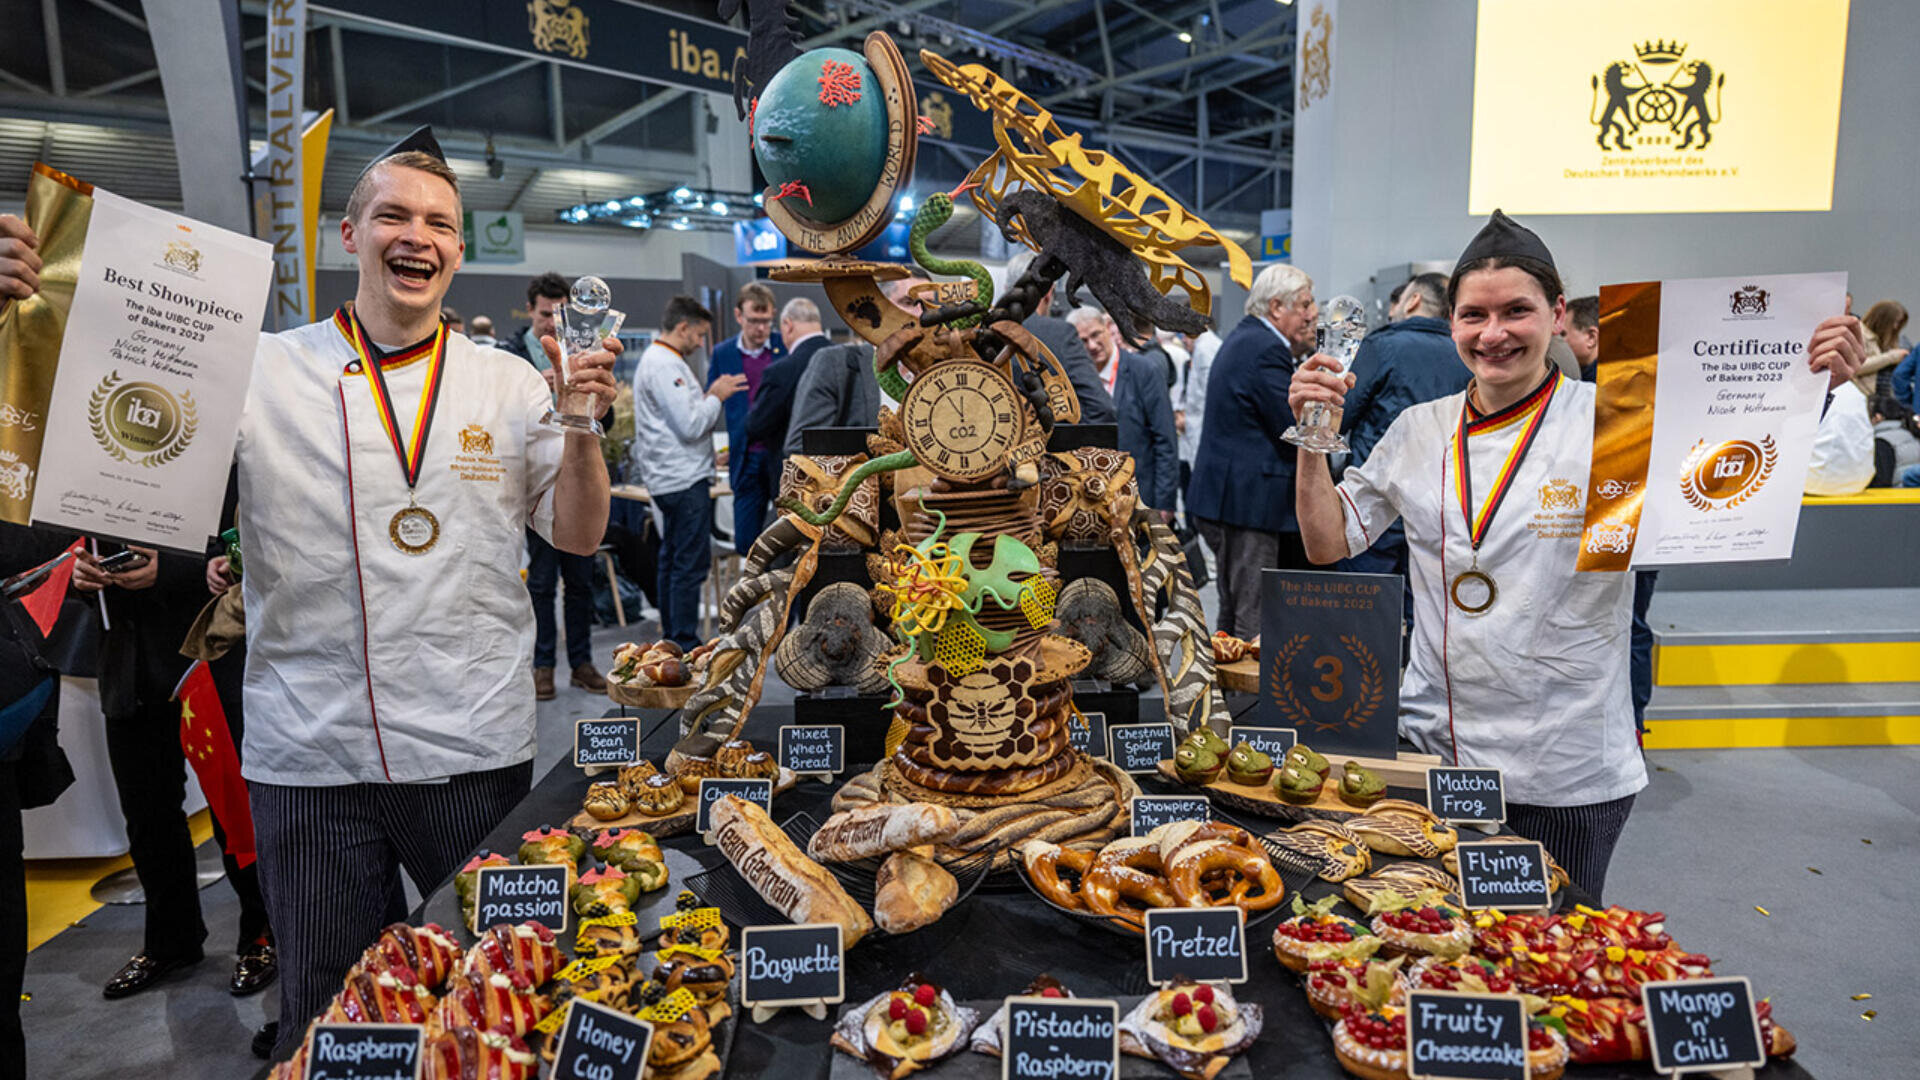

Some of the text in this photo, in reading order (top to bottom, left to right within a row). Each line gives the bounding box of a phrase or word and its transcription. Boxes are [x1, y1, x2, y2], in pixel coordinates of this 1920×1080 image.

[1685, 156, 1704, 165] des
[799, 118, 905, 250] THE ANIMAL WORLD
[103, 267, 144, 292] Best
[149, 281, 244, 324] Showpiece
[940, 282, 975, 301] SAVE
[125, 298, 215, 332] The iba UIBC CUP
[128, 313, 206, 343] of Bakers 2023
[114, 338, 147, 355] Nicole
[131, 329, 186, 357] Germany
[1693, 339, 1803, 356] Certificate
[110, 347, 147, 366] Patrick
[1701, 361, 1791, 371] The iba UIBC CUP
[1706, 373, 1783, 382] of Bakers 2023
[1050, 382, 1069, 416] OUR
[1716, 389, 1766, 401] Germany
[126, 397, 161, 429] iba
[1707, 405, 1736, 415] Nicole
[121, 431, 157, 446] Winner
[949, 425, 978, 439] CO2
[1713, 456, 1745, 479] iba
[1280, 580, 1381, 595] The iba UIBC CUP
[1286, 596, 1373, 609] of Bakers 2023
[1311, 655, 1344, 702] 3
[582, 722, 635, 737] Bacon-
[791, 728, 829, 740] Mixed
[1116, 725, 1170, 740] Chestnut
[590, 736, 624, 748] Bean
[788, 741, 834, 755] Wheat
[1125, 739, 1162, 753] Spider
[578, 746, 636, 763] Butterfly
[789, 755, 831, 769] Bread
[1126, 754, 1161, 768] Bread
[1436, 773, 1499, 792] Matcha
[704, 786, 769, 801] Chcolate
[1441, 794, 1487, 817] Frog
[1466, 850, 1533, 877] Flying
[488, 874, 560, 897] Matcha
[1468, 876, 1546, 894] Tomatoes
[482, 898, 563, 925] passion
[1151, 925, 1240, 959] Pretzel
[746, 943, 840, 984] Baguette
[1658, 989, 1735, 1019] Mango
[1014, 1010, 1113, 1038] Pistachio
[1418, 1003, 1504, 1040] Fruity
[317, 1031, 417, 1065] Raspberry
[576, 1013, 636, 1064] Honey
[1415, 1038, 1525, 1066] Cheesecake
[1673, 1037, 1729, 1063] Chili
[573, 1053, 614, 1080] Cup
[1016, 1052, 1115, 1080] Raspberry
